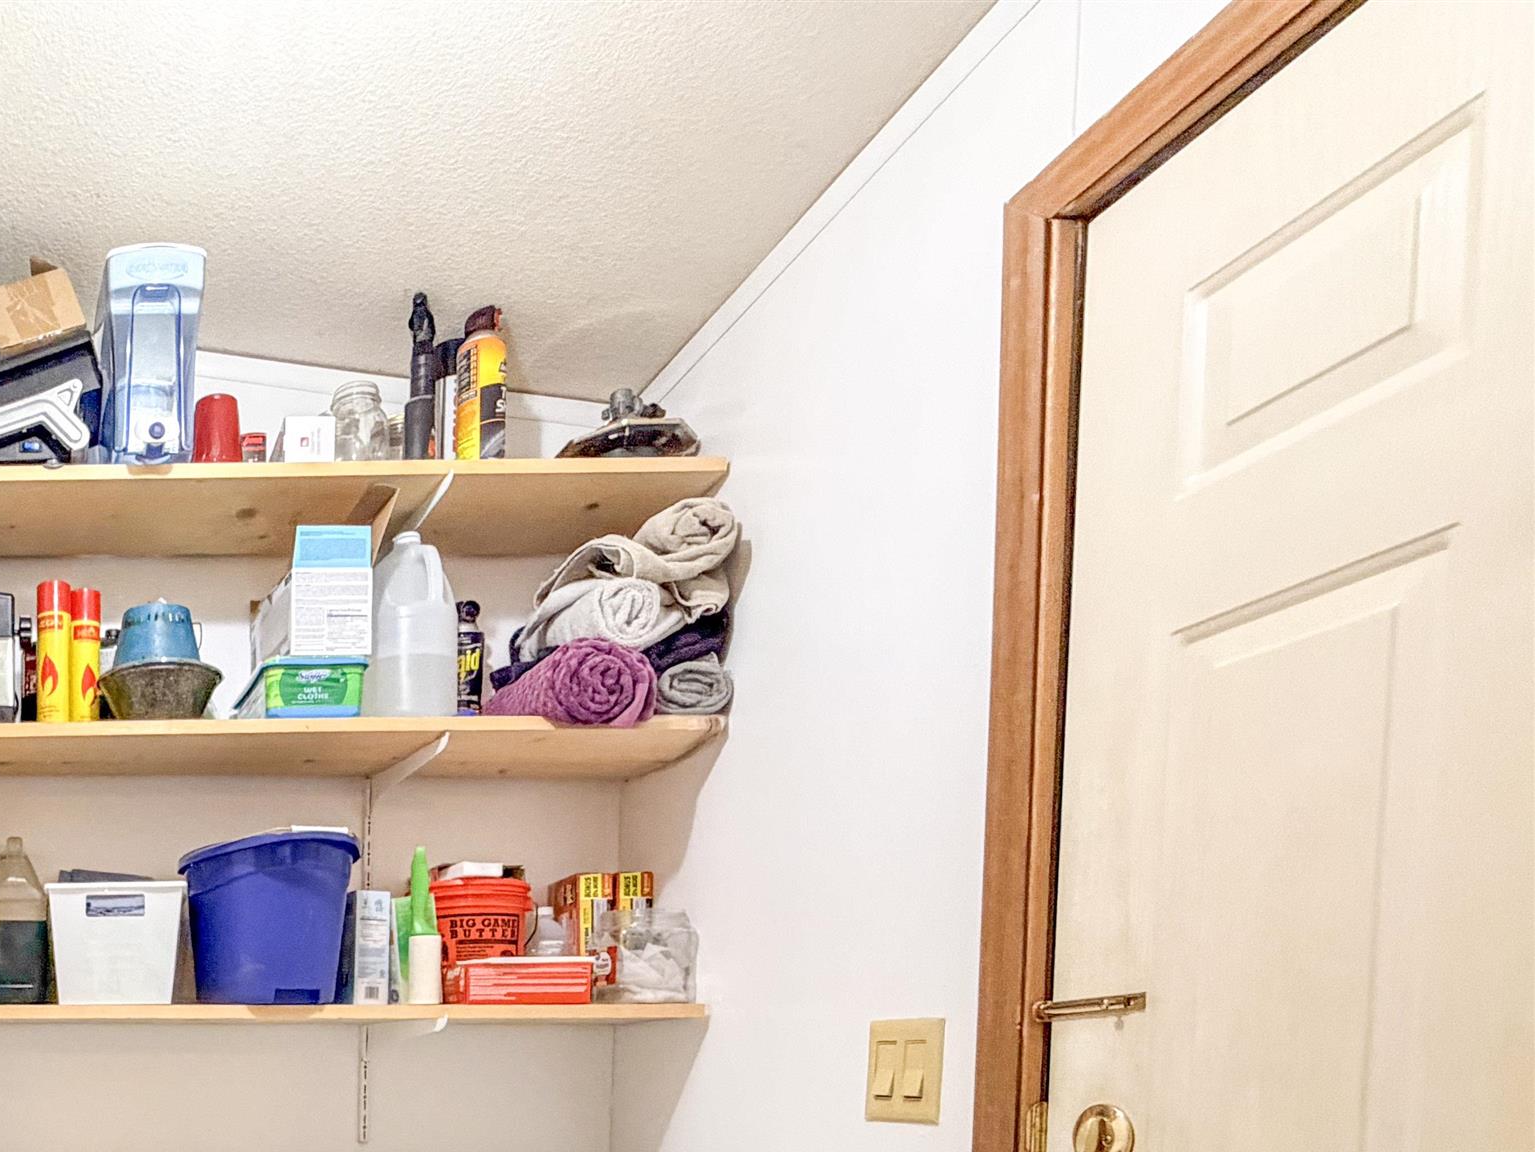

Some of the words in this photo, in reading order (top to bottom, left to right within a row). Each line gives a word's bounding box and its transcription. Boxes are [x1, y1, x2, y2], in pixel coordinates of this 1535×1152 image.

[457, 647, 480, 673] aid
[449, 919, 476, 929] BIG
[481, 918, 517, 929] GAME
[449, 928, 517, 939] BUTTER
